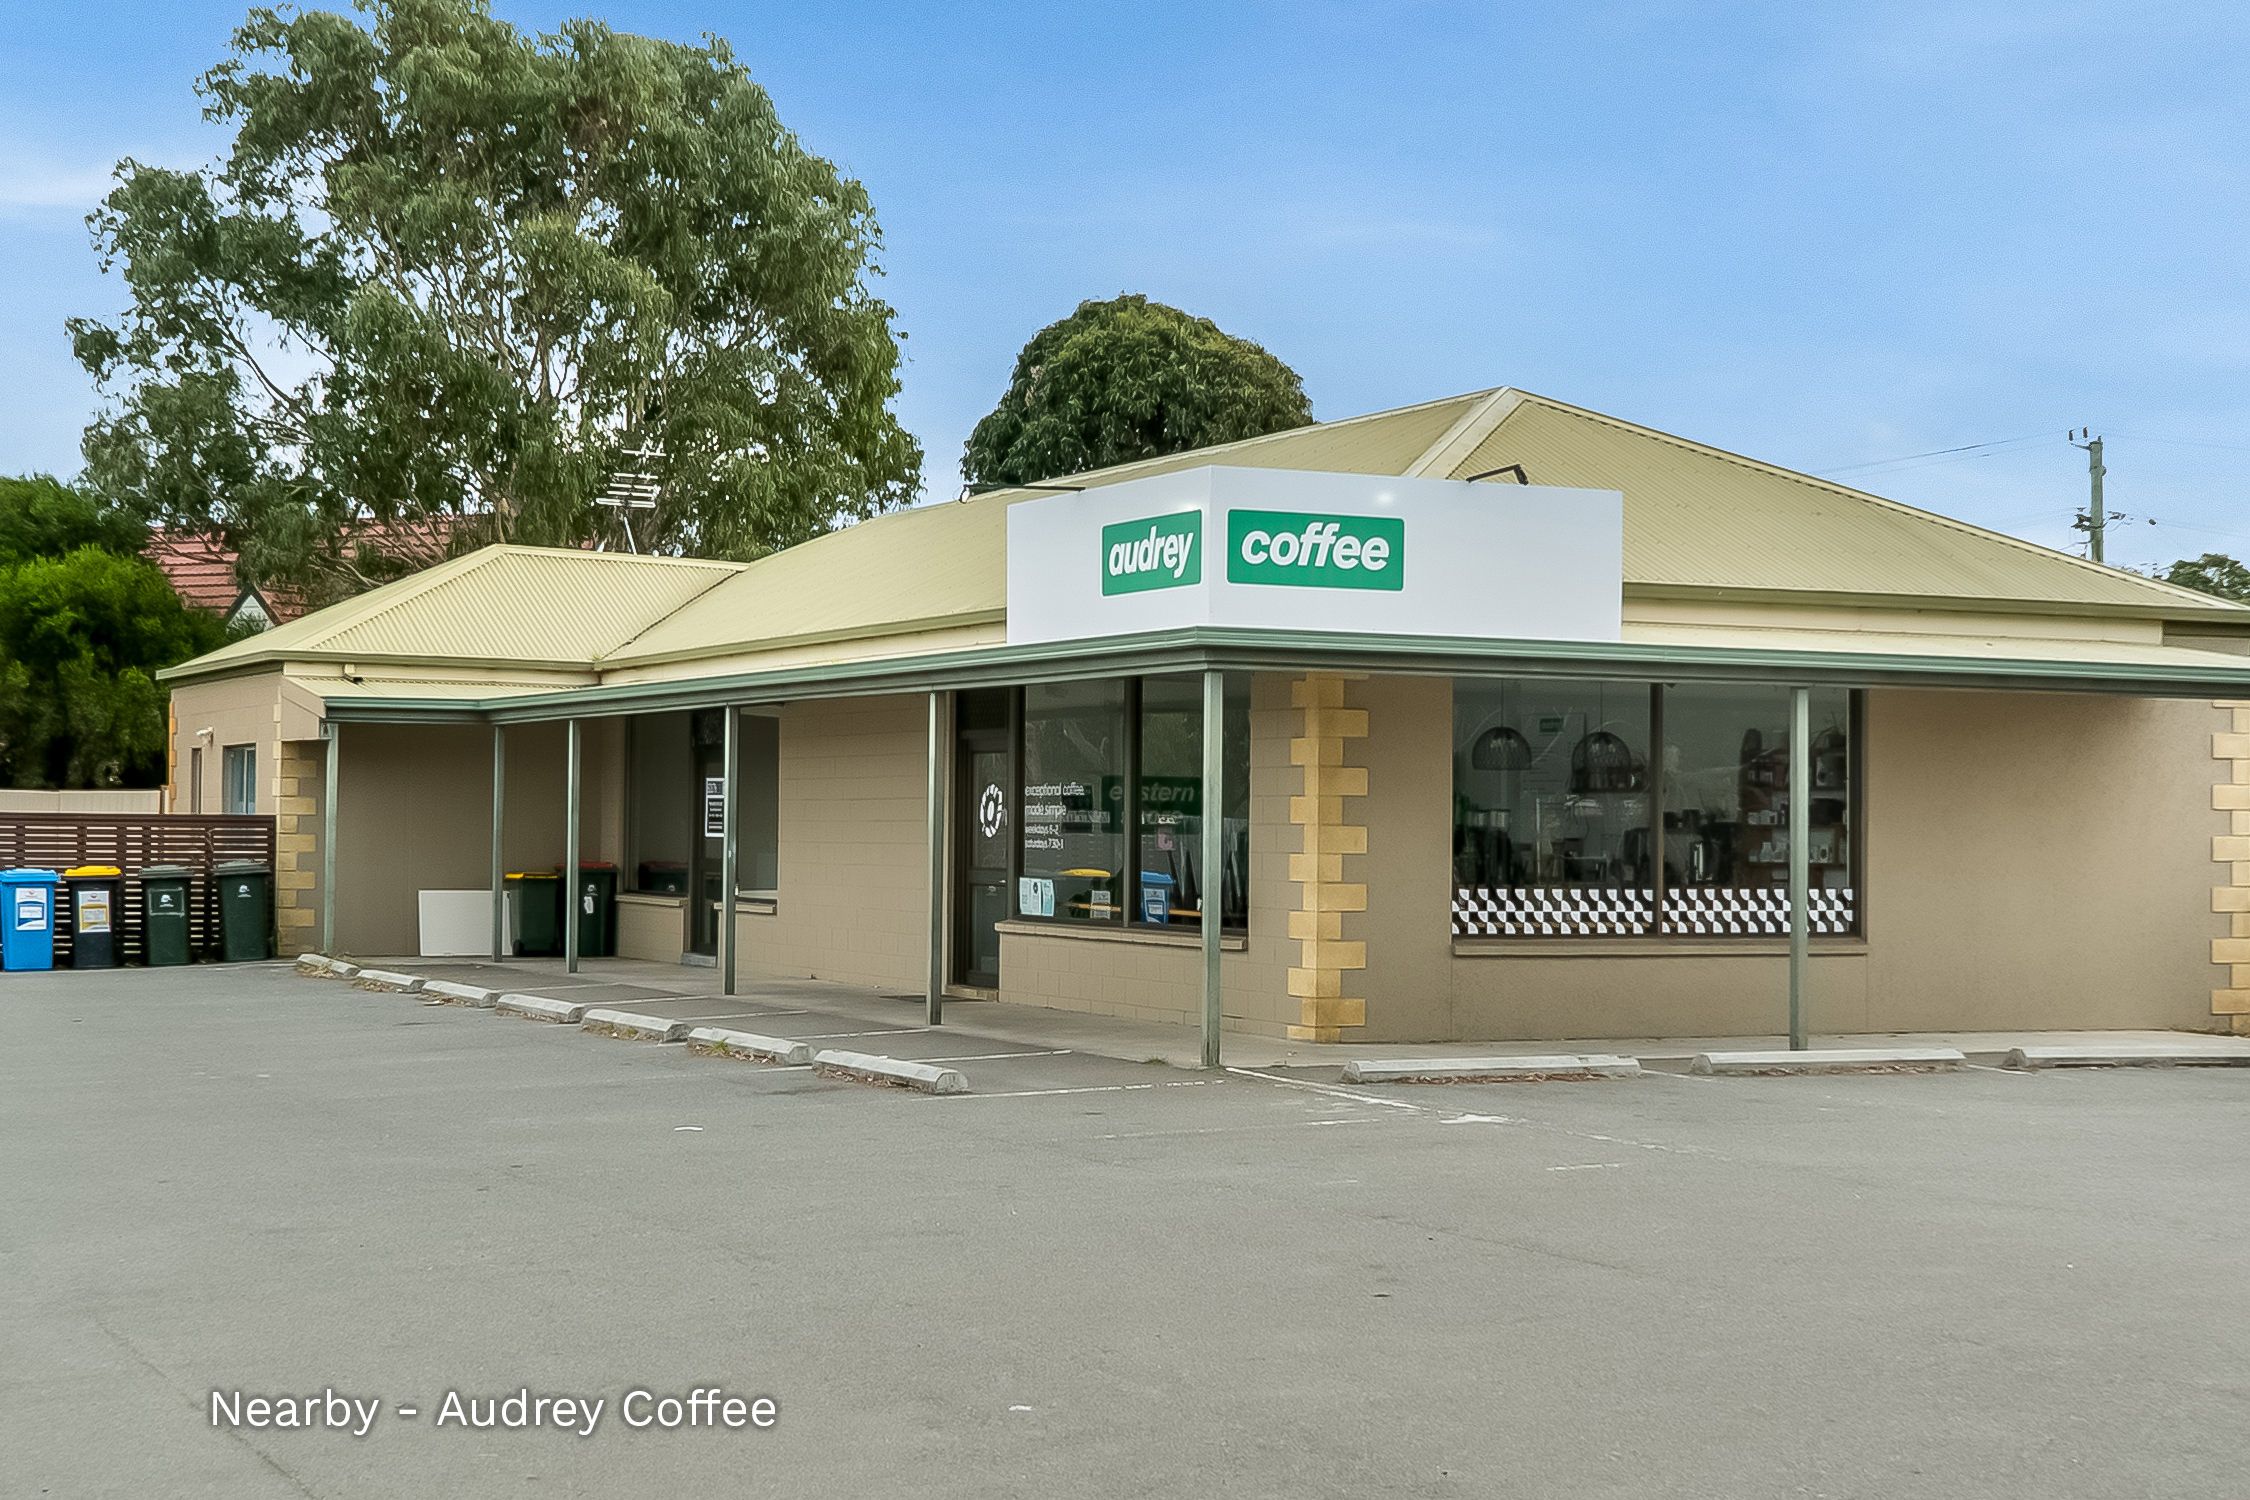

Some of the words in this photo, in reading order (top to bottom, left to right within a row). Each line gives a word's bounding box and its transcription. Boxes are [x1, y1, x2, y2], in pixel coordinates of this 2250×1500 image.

[1109, 525, 1195, 579] audrey
[1241, 521, 1392, 572] coffee
[1025, 783, 1061, 798] exceptional
[1063, 782, 1085, 796] coffee
[1109, 782, 1195, 801] estern
[1025, 802, 1044, 815] made
[1045, 802, 1067, 819] simple
